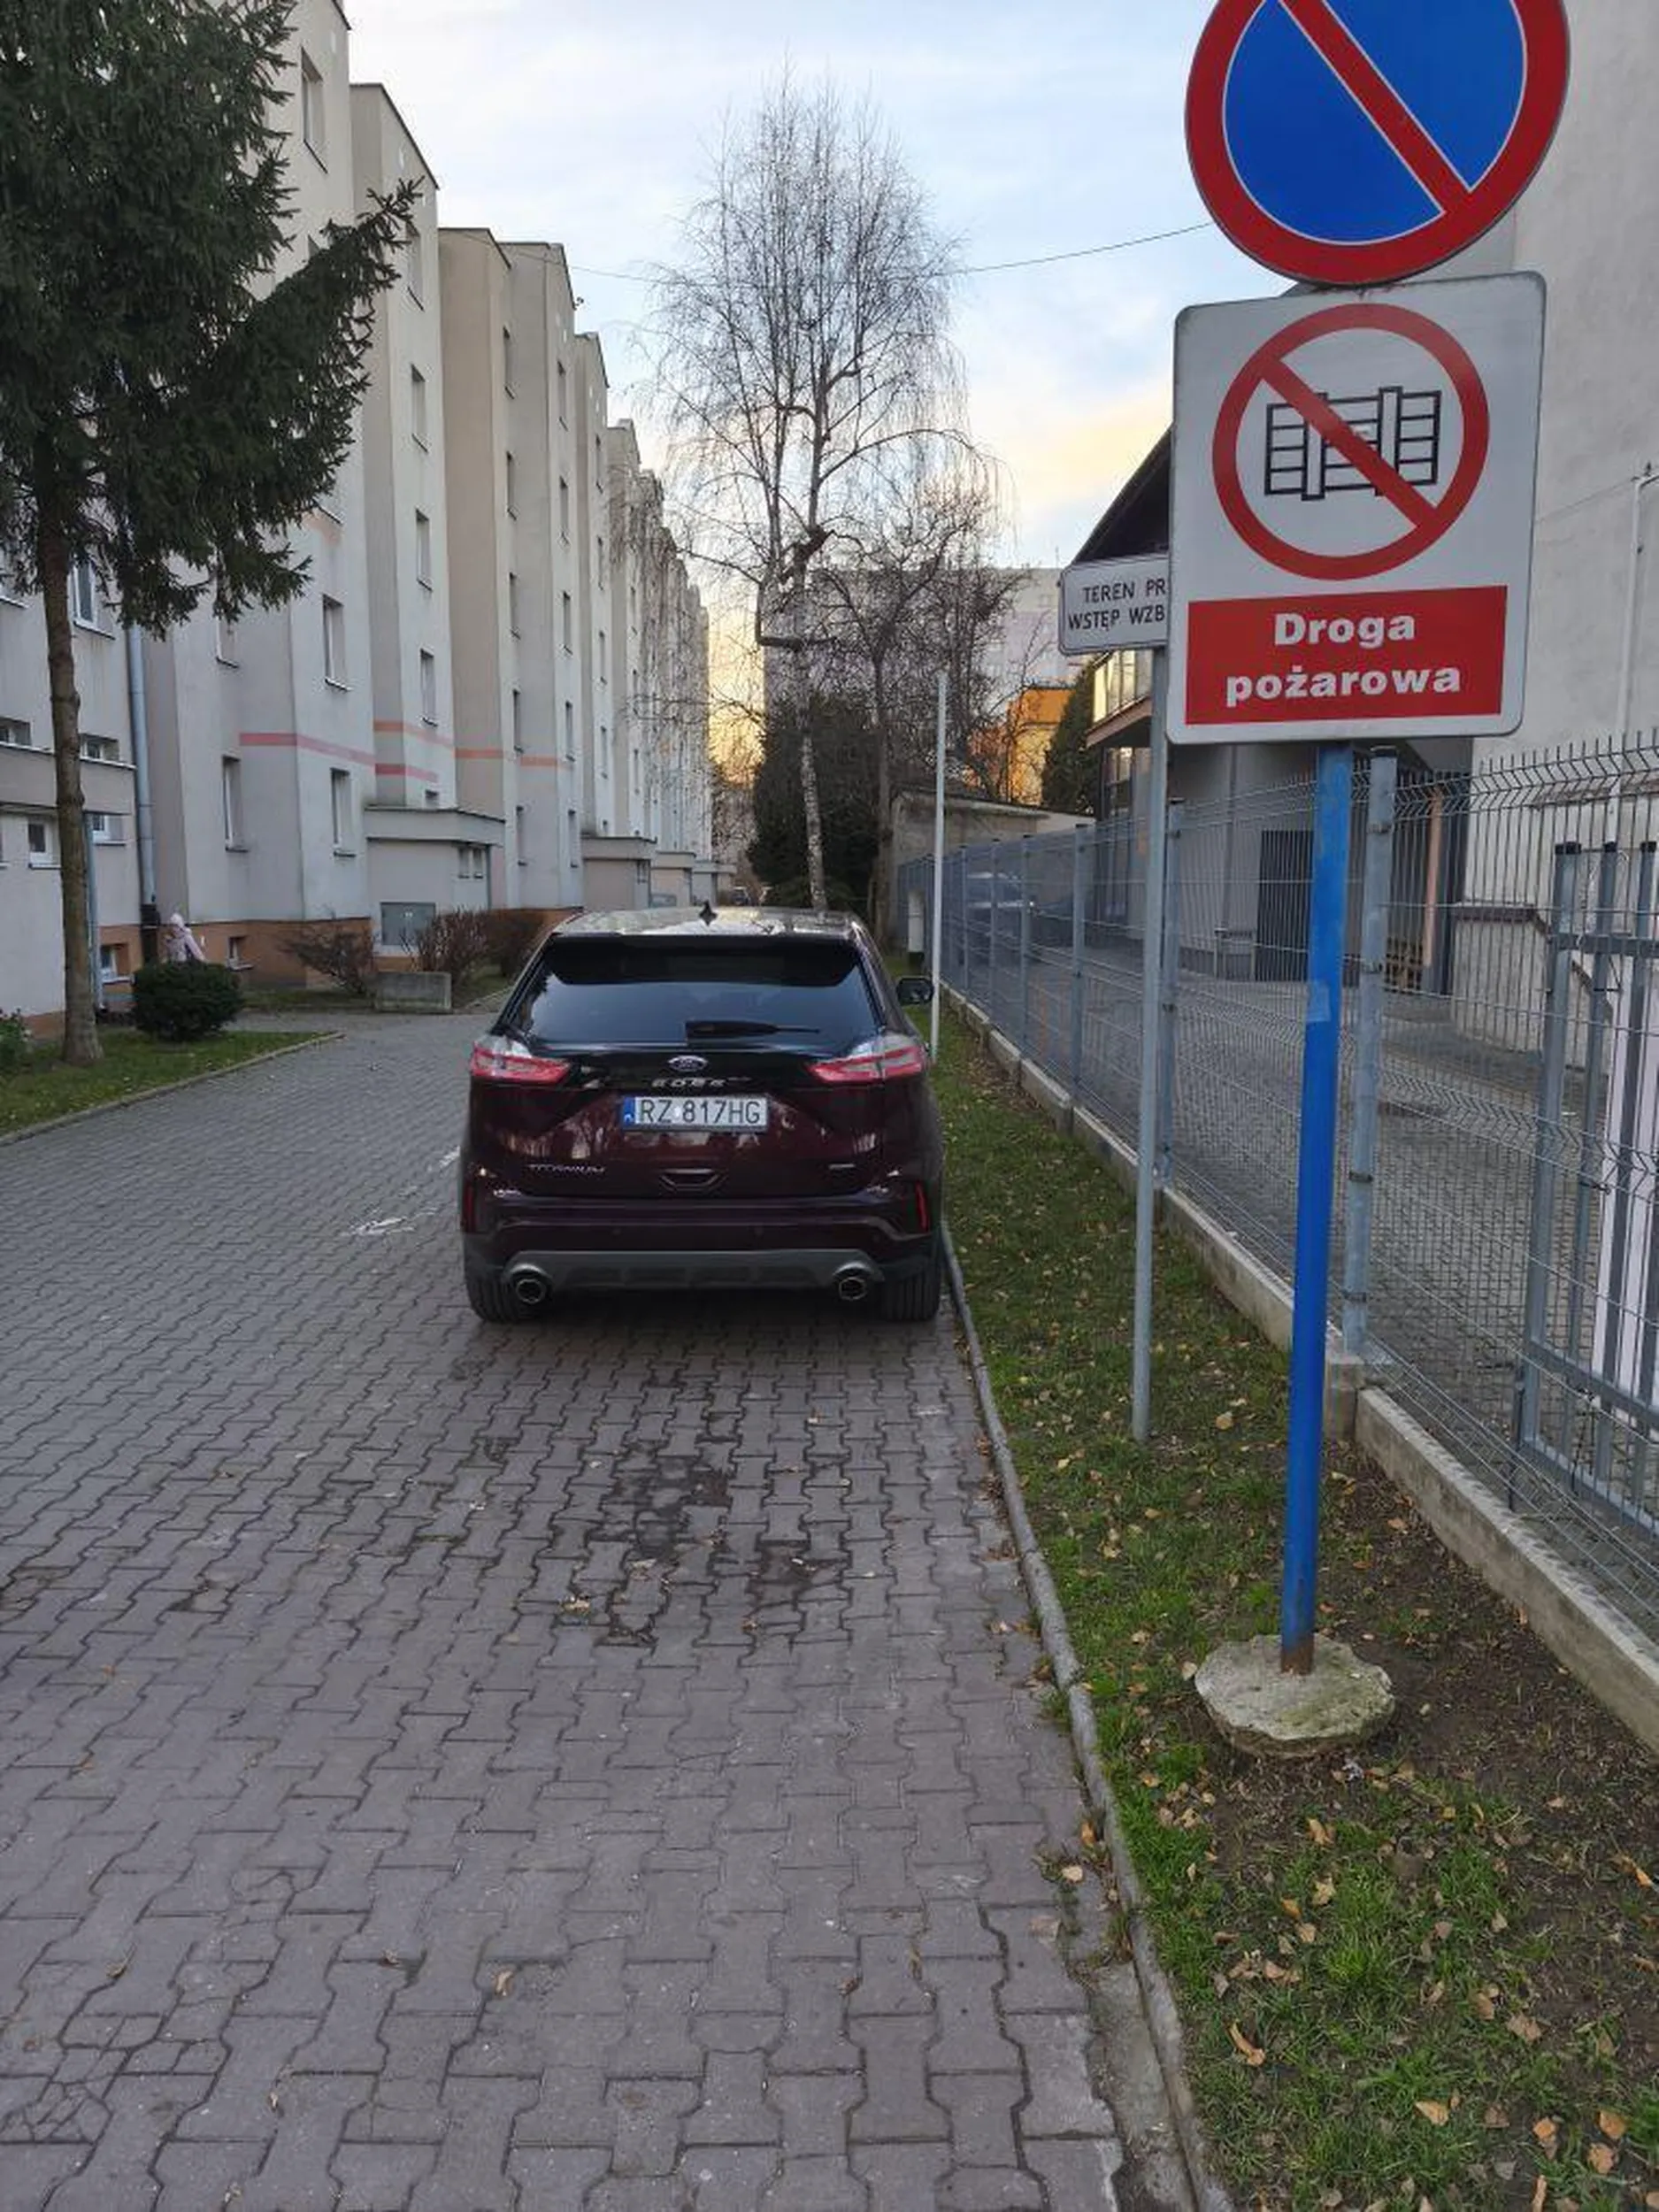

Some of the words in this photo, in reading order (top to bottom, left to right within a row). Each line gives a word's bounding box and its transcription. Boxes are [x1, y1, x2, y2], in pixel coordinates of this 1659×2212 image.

[1083, 581, 1135, 603] TEREN
[1145, 578, 1166, 596] PR
[1068, 609, 1120, 632] WSTĘP
[1129, 604, 1165, 625] WZB
[1275, 612, 1415, 649] Droga
[1225, 664, 1460, 708] pożarowa
[641, 1100, 672, 1124] RZ
[683, 1100, 760, 1125] 817HG
